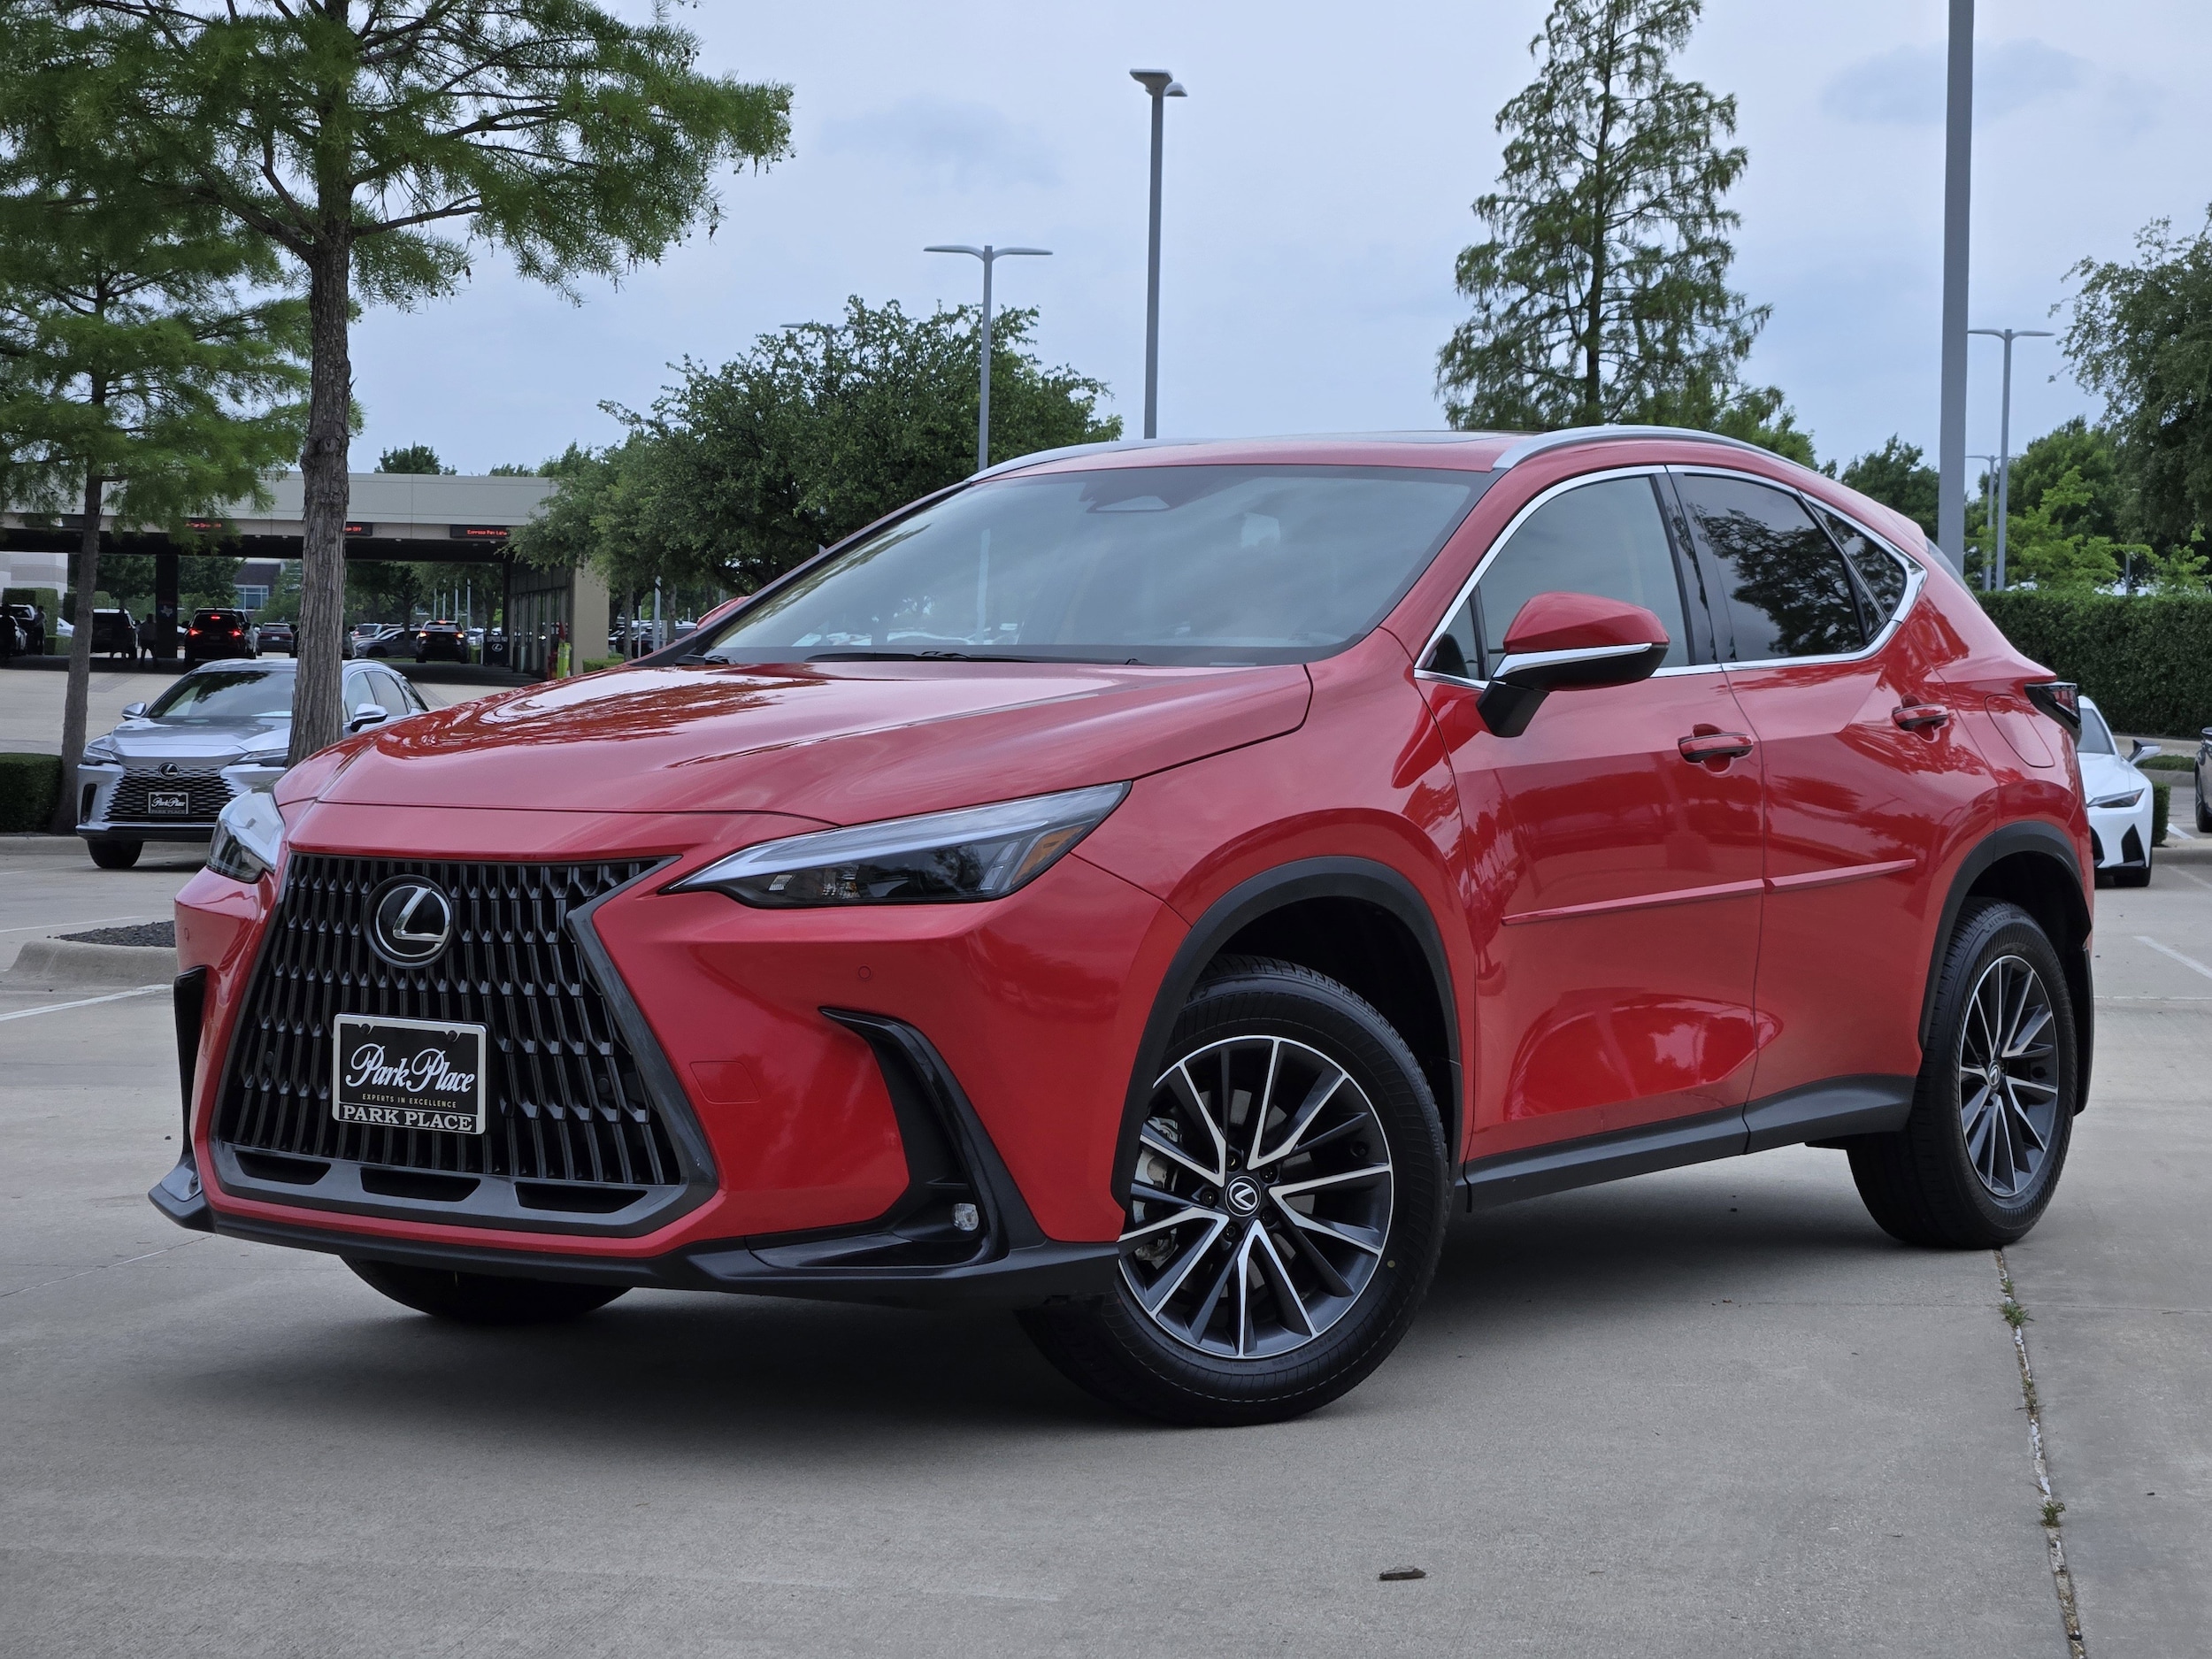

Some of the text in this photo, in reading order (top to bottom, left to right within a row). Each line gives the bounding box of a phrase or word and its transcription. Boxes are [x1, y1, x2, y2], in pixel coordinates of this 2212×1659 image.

[345, 1042, 475, 1093] Park Place
[362, 1093, 394, 1102] EXPERTS
[409, 1098, 457, 1109] EXCELLENCE
[342, 1105, 472, 1132] PARK PLACE
